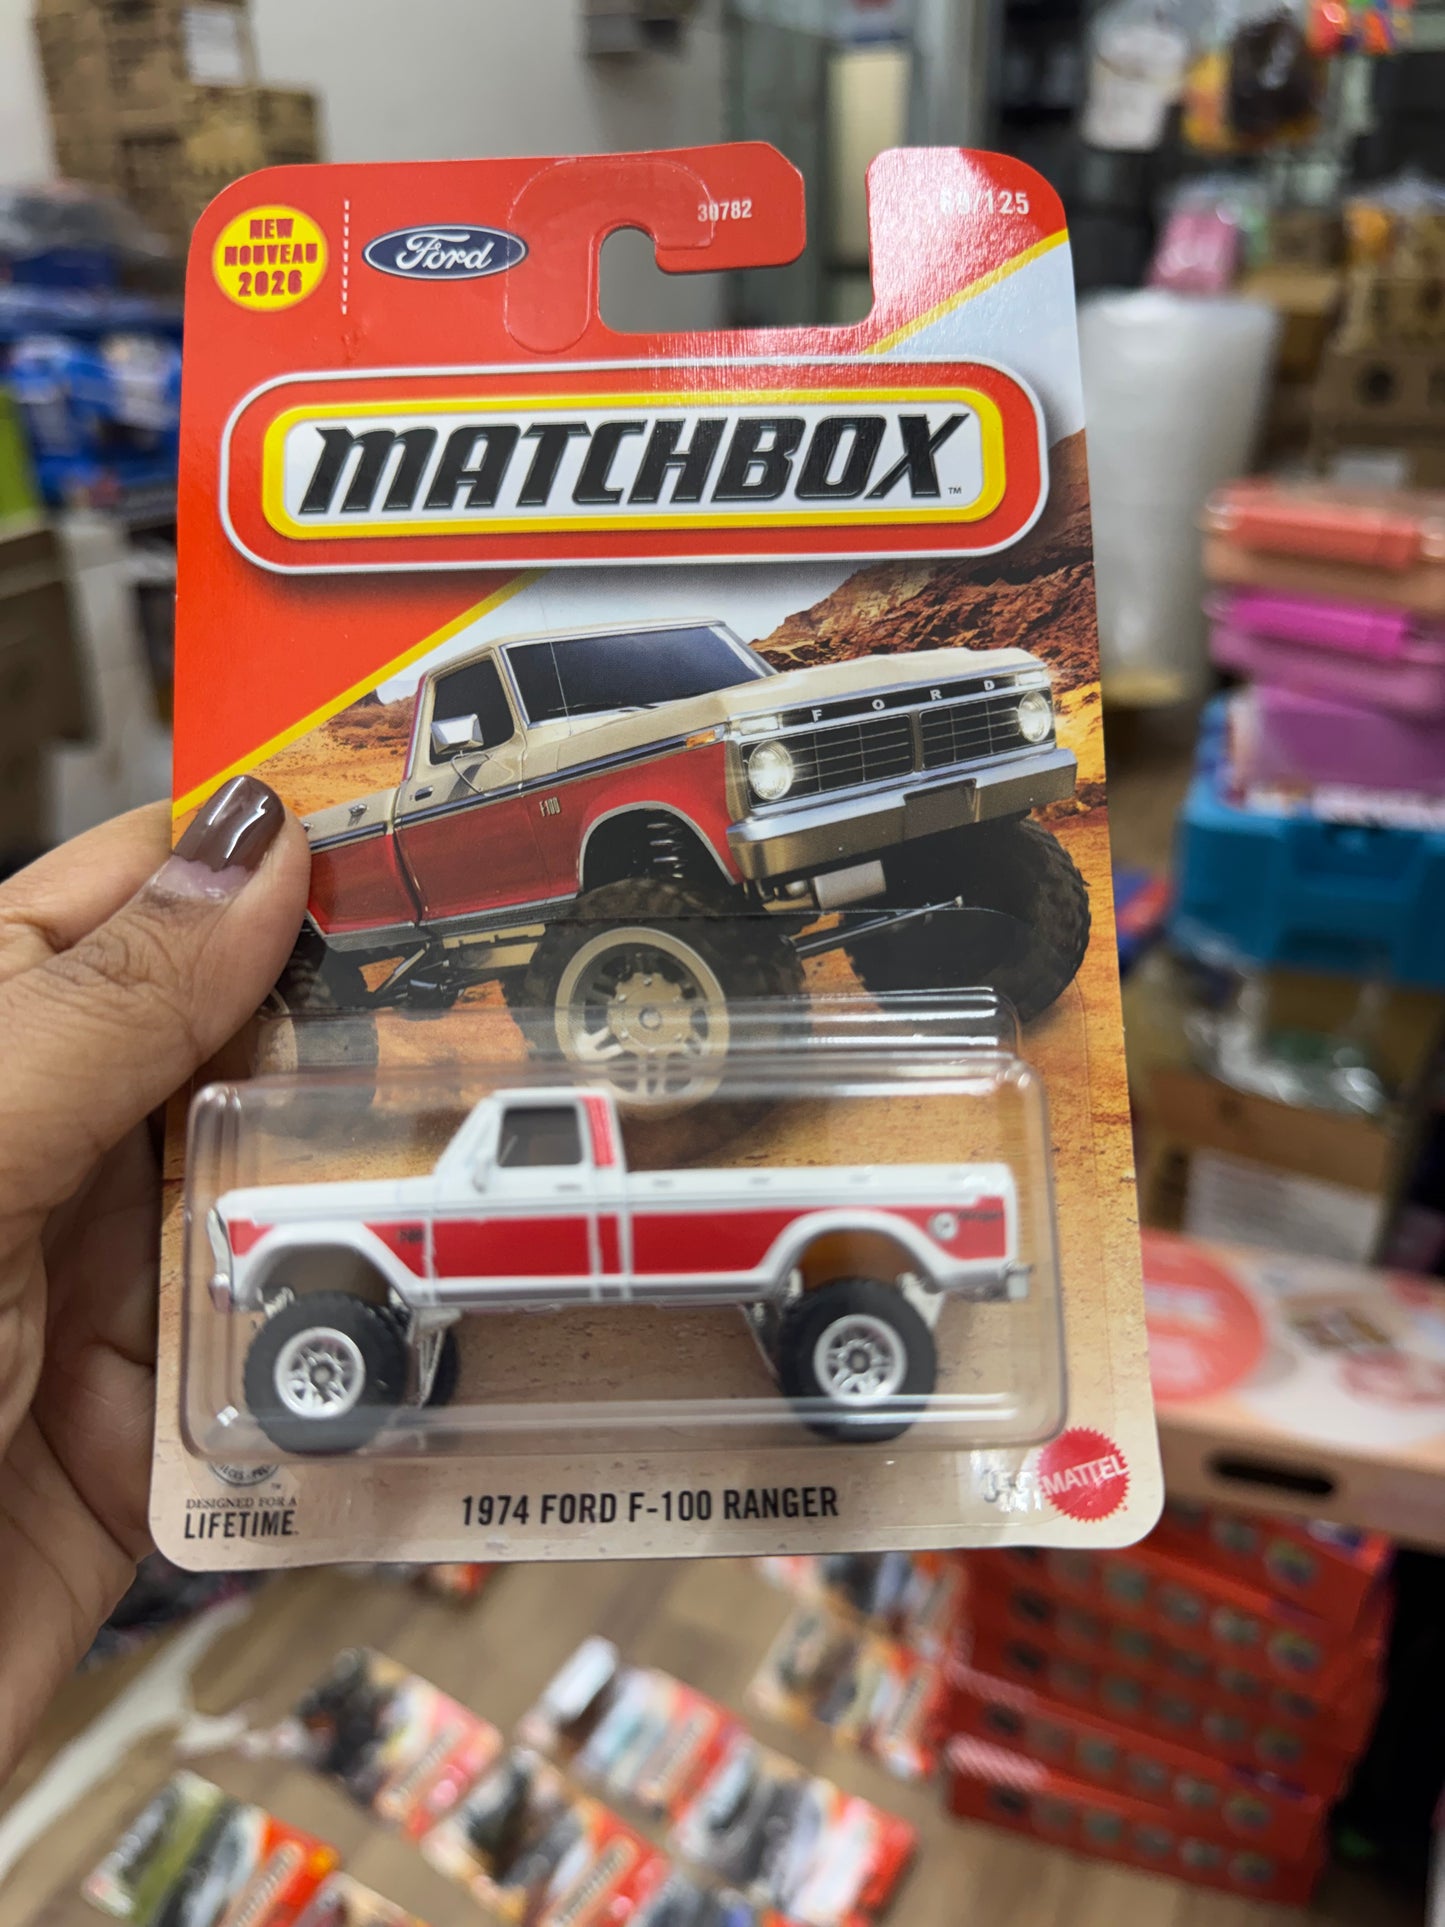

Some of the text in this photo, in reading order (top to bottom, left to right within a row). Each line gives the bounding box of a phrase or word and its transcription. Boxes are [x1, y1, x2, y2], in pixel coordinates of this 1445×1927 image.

[697, 198, 753, 222] 30782
[249, 218, 294, 240] NEW
[224, 243, 318, 267] NOUVEAU
[396, 232, 494, 271] Ford
[238, 270, 303, 297] 2026
[298, 413, 970, 515] MATCHBOX
[811, 680, 996, 722] FORD
[1042, 1454, 1130, 1496] MATTEL
[186, 1496, 298, 1509] DESIGNED FOR A
[462, 1486, 839, 1526] 1974 FORD F-100 RANGER
